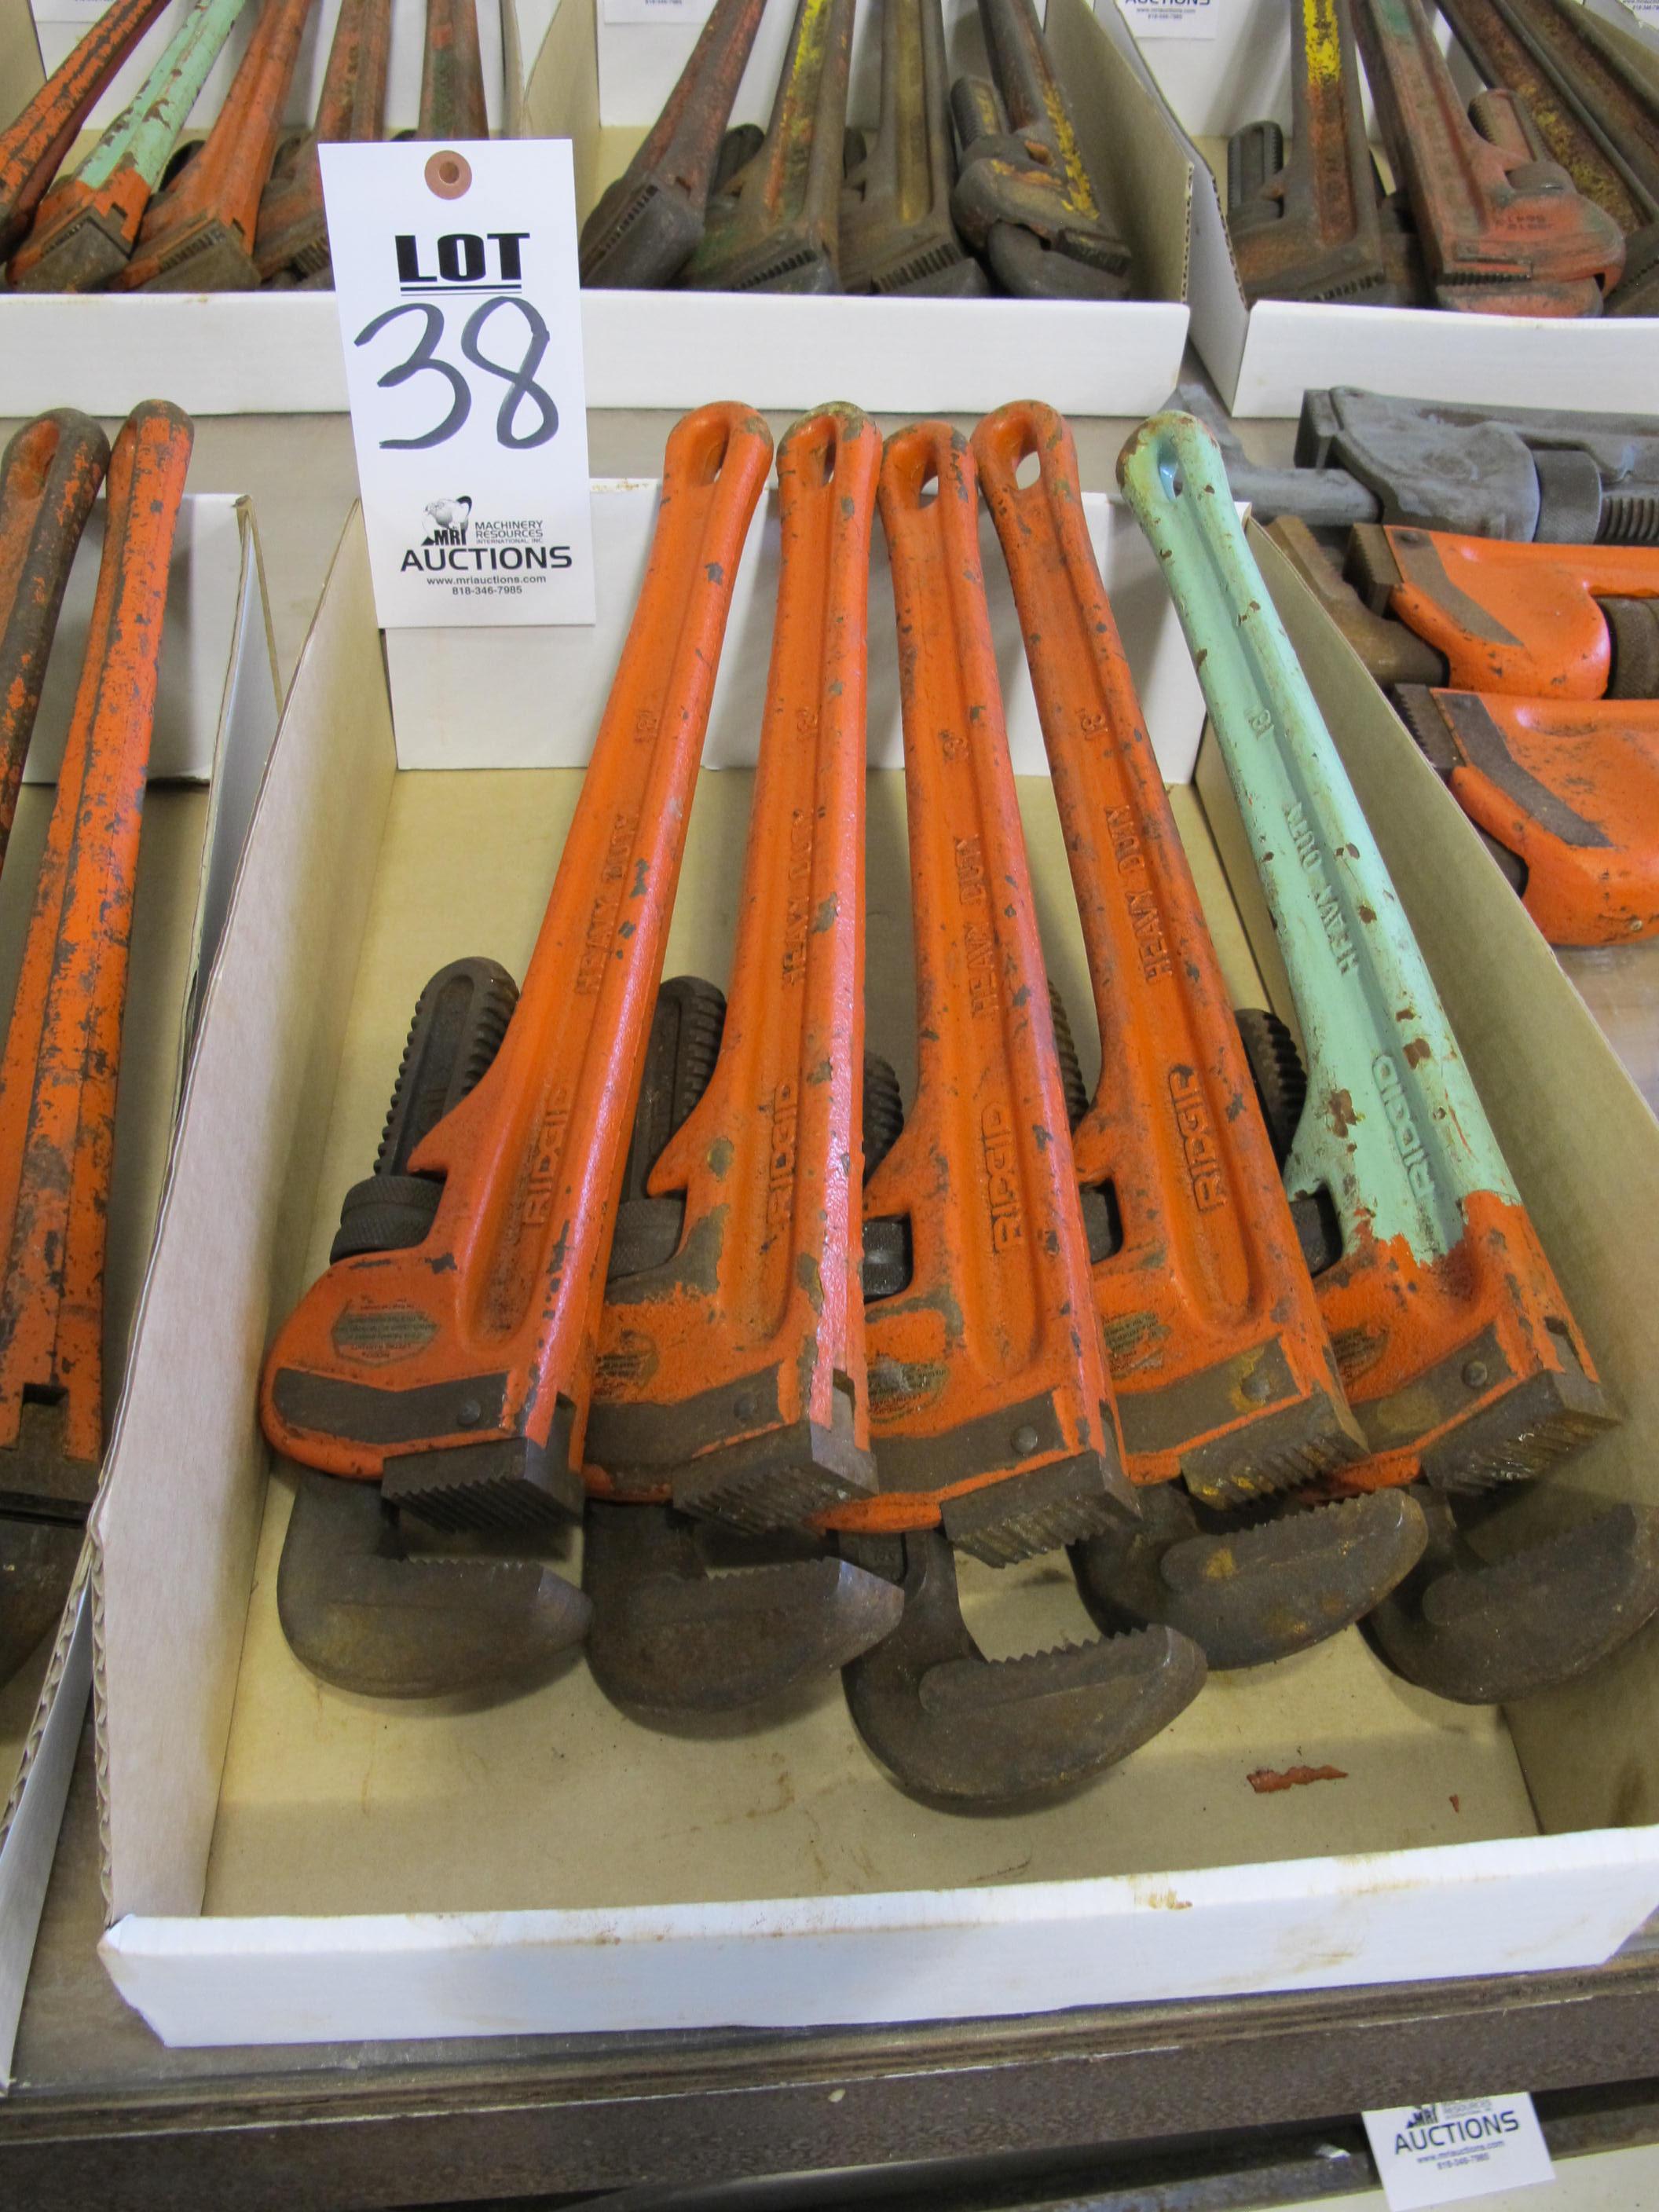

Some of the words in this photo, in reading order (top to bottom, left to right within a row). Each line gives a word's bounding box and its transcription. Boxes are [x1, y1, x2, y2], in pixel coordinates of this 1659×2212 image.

[394, 233, 530, 283] LOT
[353, 296, 559, 449] 38
[401, 545, 573, 572] AUCTIONS
[434, 529, 467, 546] MRI
[474, 520, 543, 530] MACHINERY
[475, 529, 544, 539] RESOURCES
[427, 574, 547, 585] www.mriauctions.com
[452, 585, 523, 595] 818-346-7985
[1103, 804, 1147, 873] DUTY
[1284, 801, 1323, 870] DUTY
[1123, 888, 1174, 983] HEAVY
[1314, 884, 1361, 976] HEAVY
[523, 1078, 572, 1227] RIDGID
[1168, 1064, 1227, 1213] RIDGID
[1372, 1053, 1436, 1199] RIDGID
[980, 1100, 1024, 1254] RIDGID
[1395, 2110, 1520, 2155] AUCTIONS
